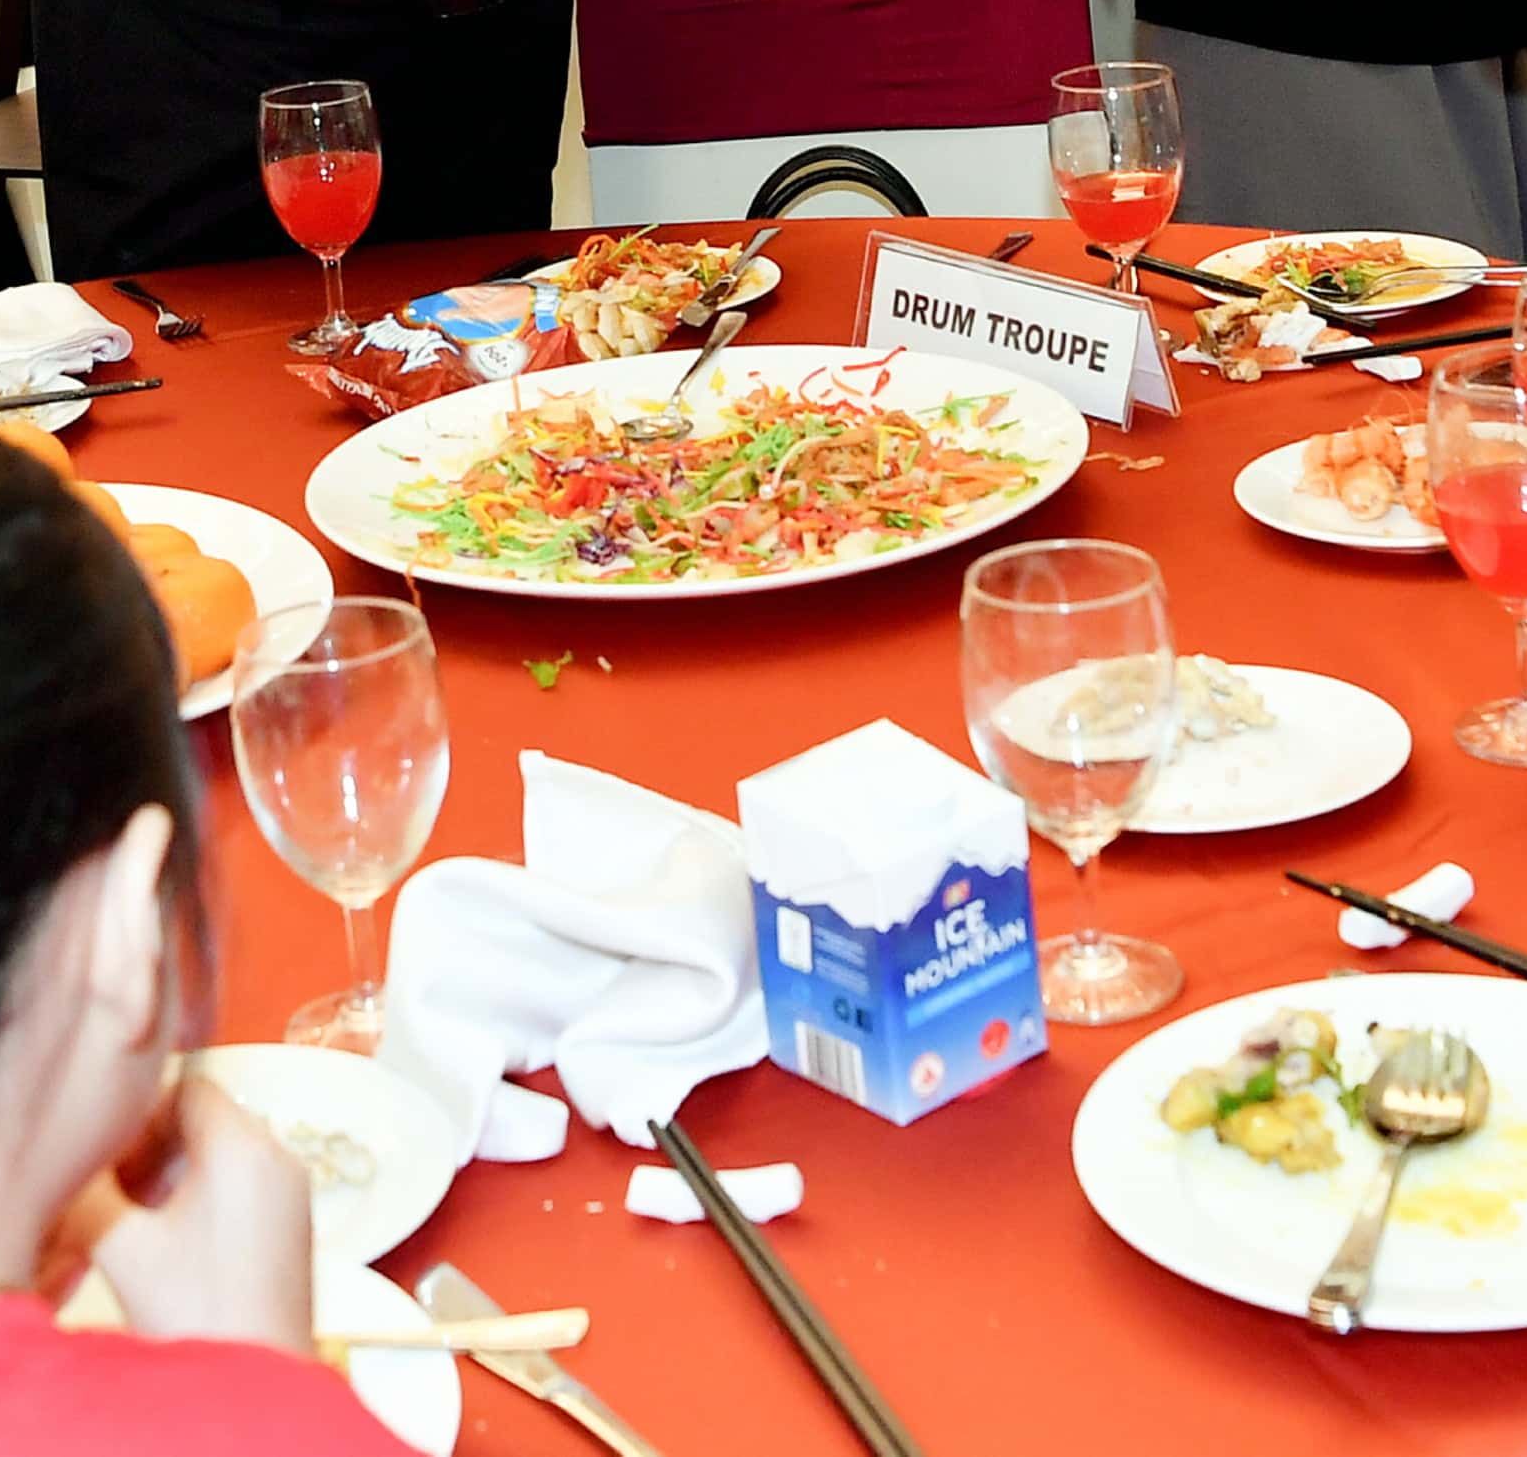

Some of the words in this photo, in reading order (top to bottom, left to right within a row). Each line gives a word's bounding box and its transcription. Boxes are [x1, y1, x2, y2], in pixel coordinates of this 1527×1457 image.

[892, 288, 976, 338] DRUM
[986, 311, 1110, 373] TROUPE
[904, 919, 1027, 999] MOUNTAIN
[934, 898, 987, 953] ICE
